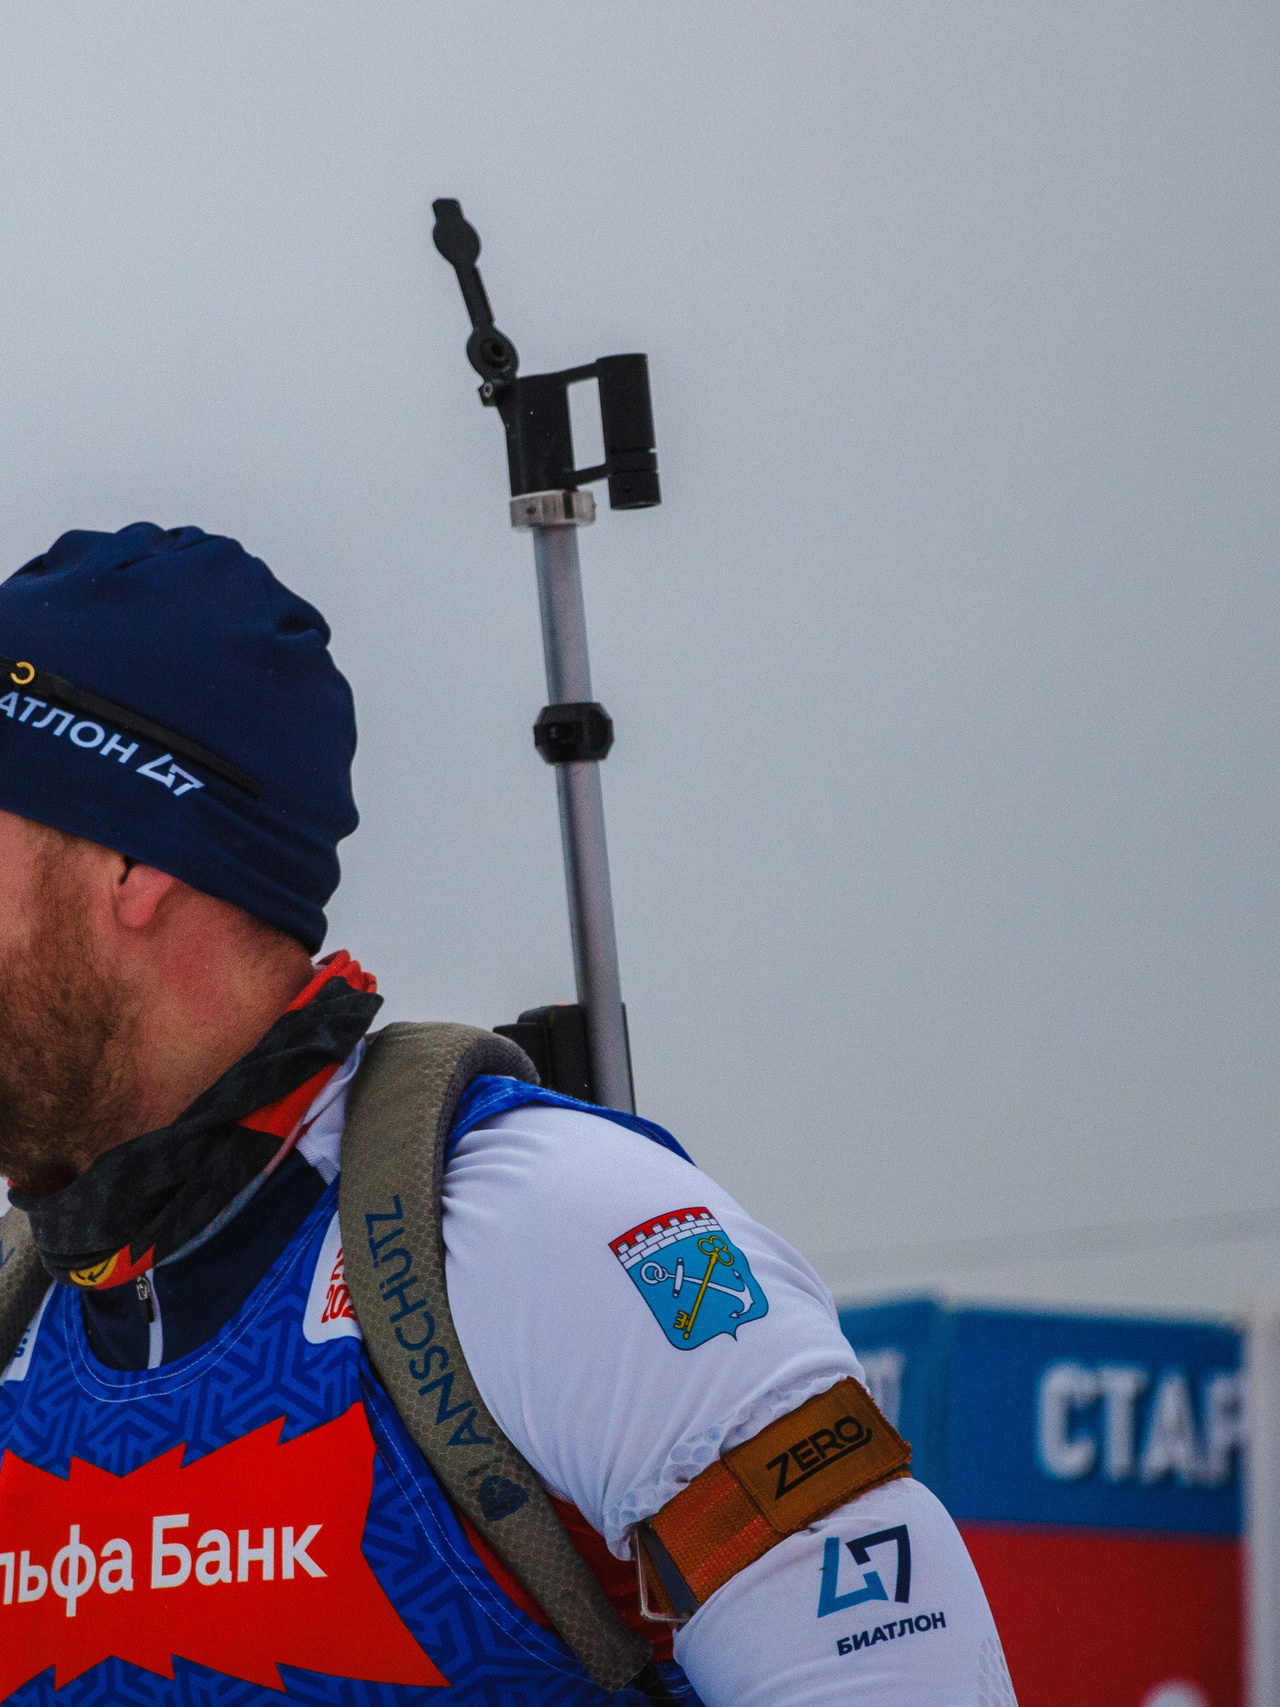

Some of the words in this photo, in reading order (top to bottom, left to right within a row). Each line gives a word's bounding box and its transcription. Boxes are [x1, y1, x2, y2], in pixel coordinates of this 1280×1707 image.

[765, 1416, 873, 1501] ZERO
[150, 1513, 328, 1590] Банк
[836, 1611, 946, 1656] БИАТЛОН
